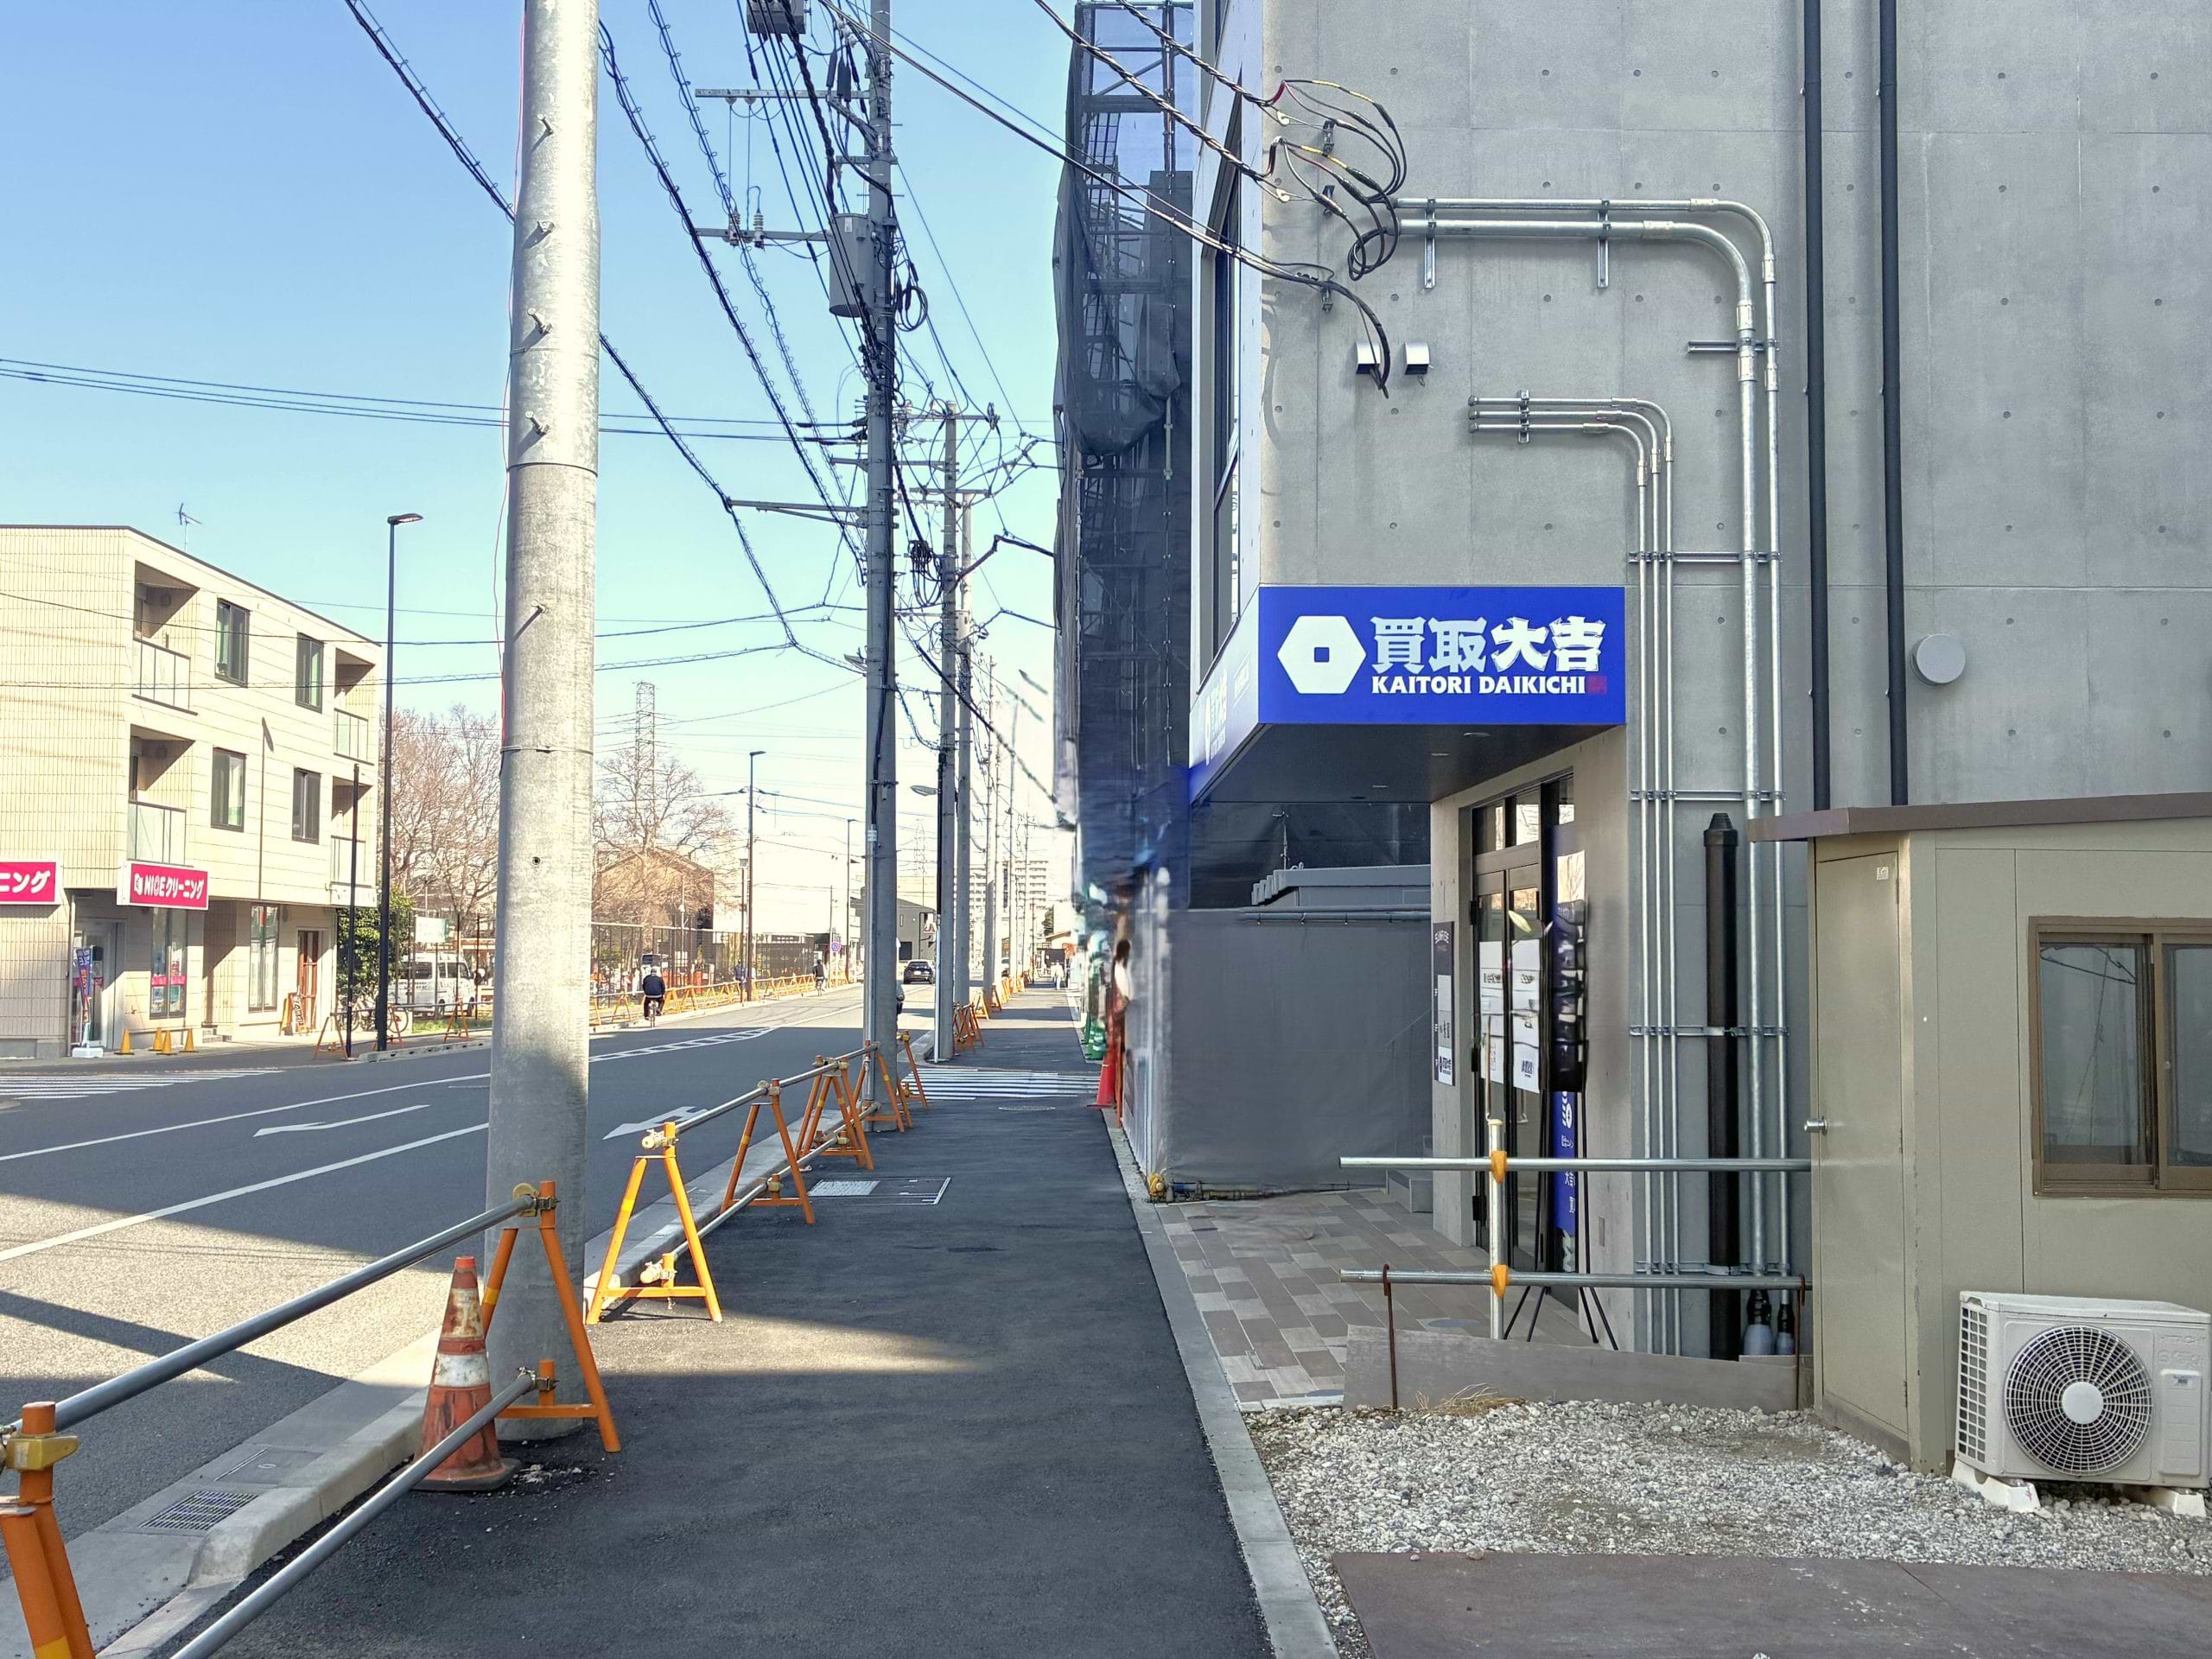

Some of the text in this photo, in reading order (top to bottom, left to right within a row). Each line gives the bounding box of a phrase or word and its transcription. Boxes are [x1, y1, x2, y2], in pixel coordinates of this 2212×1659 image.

[1370, 616, 1606, 674] 買取大吉
[1372, 676, 1586, 695] KAITORI DAIKICHI
